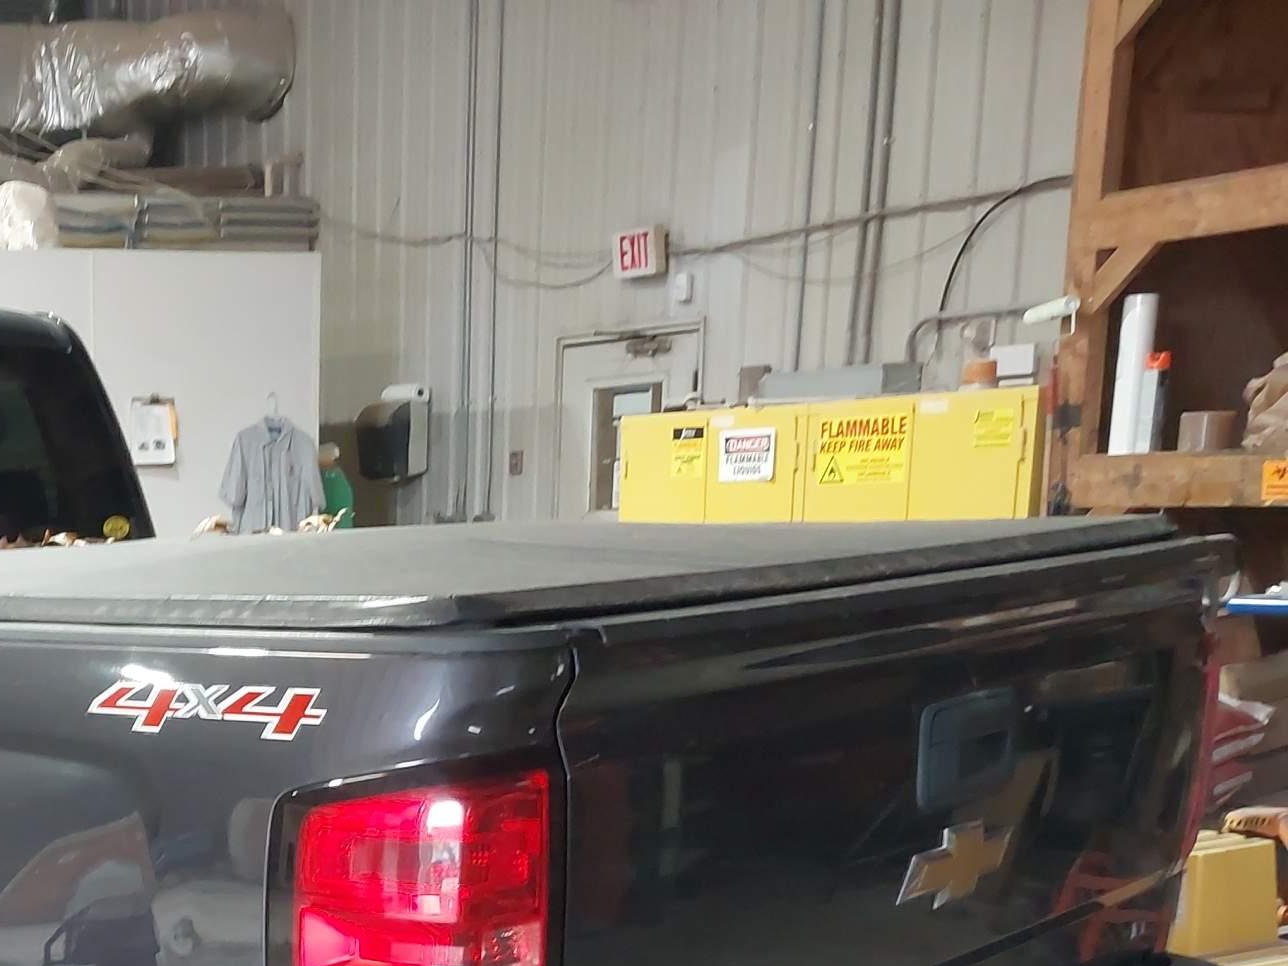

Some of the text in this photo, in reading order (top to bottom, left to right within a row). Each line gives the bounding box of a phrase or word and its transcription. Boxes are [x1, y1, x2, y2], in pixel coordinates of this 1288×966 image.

[619, 231, 649, 271] EXIT
[821, 416, 907, 439] FLAMMABLE
[728, 437, 768, 450] DANGER
[819, 437, 905, 454] KEEP FIRE AWAY
[725, 452, 769, 465] FLAMMABLE
